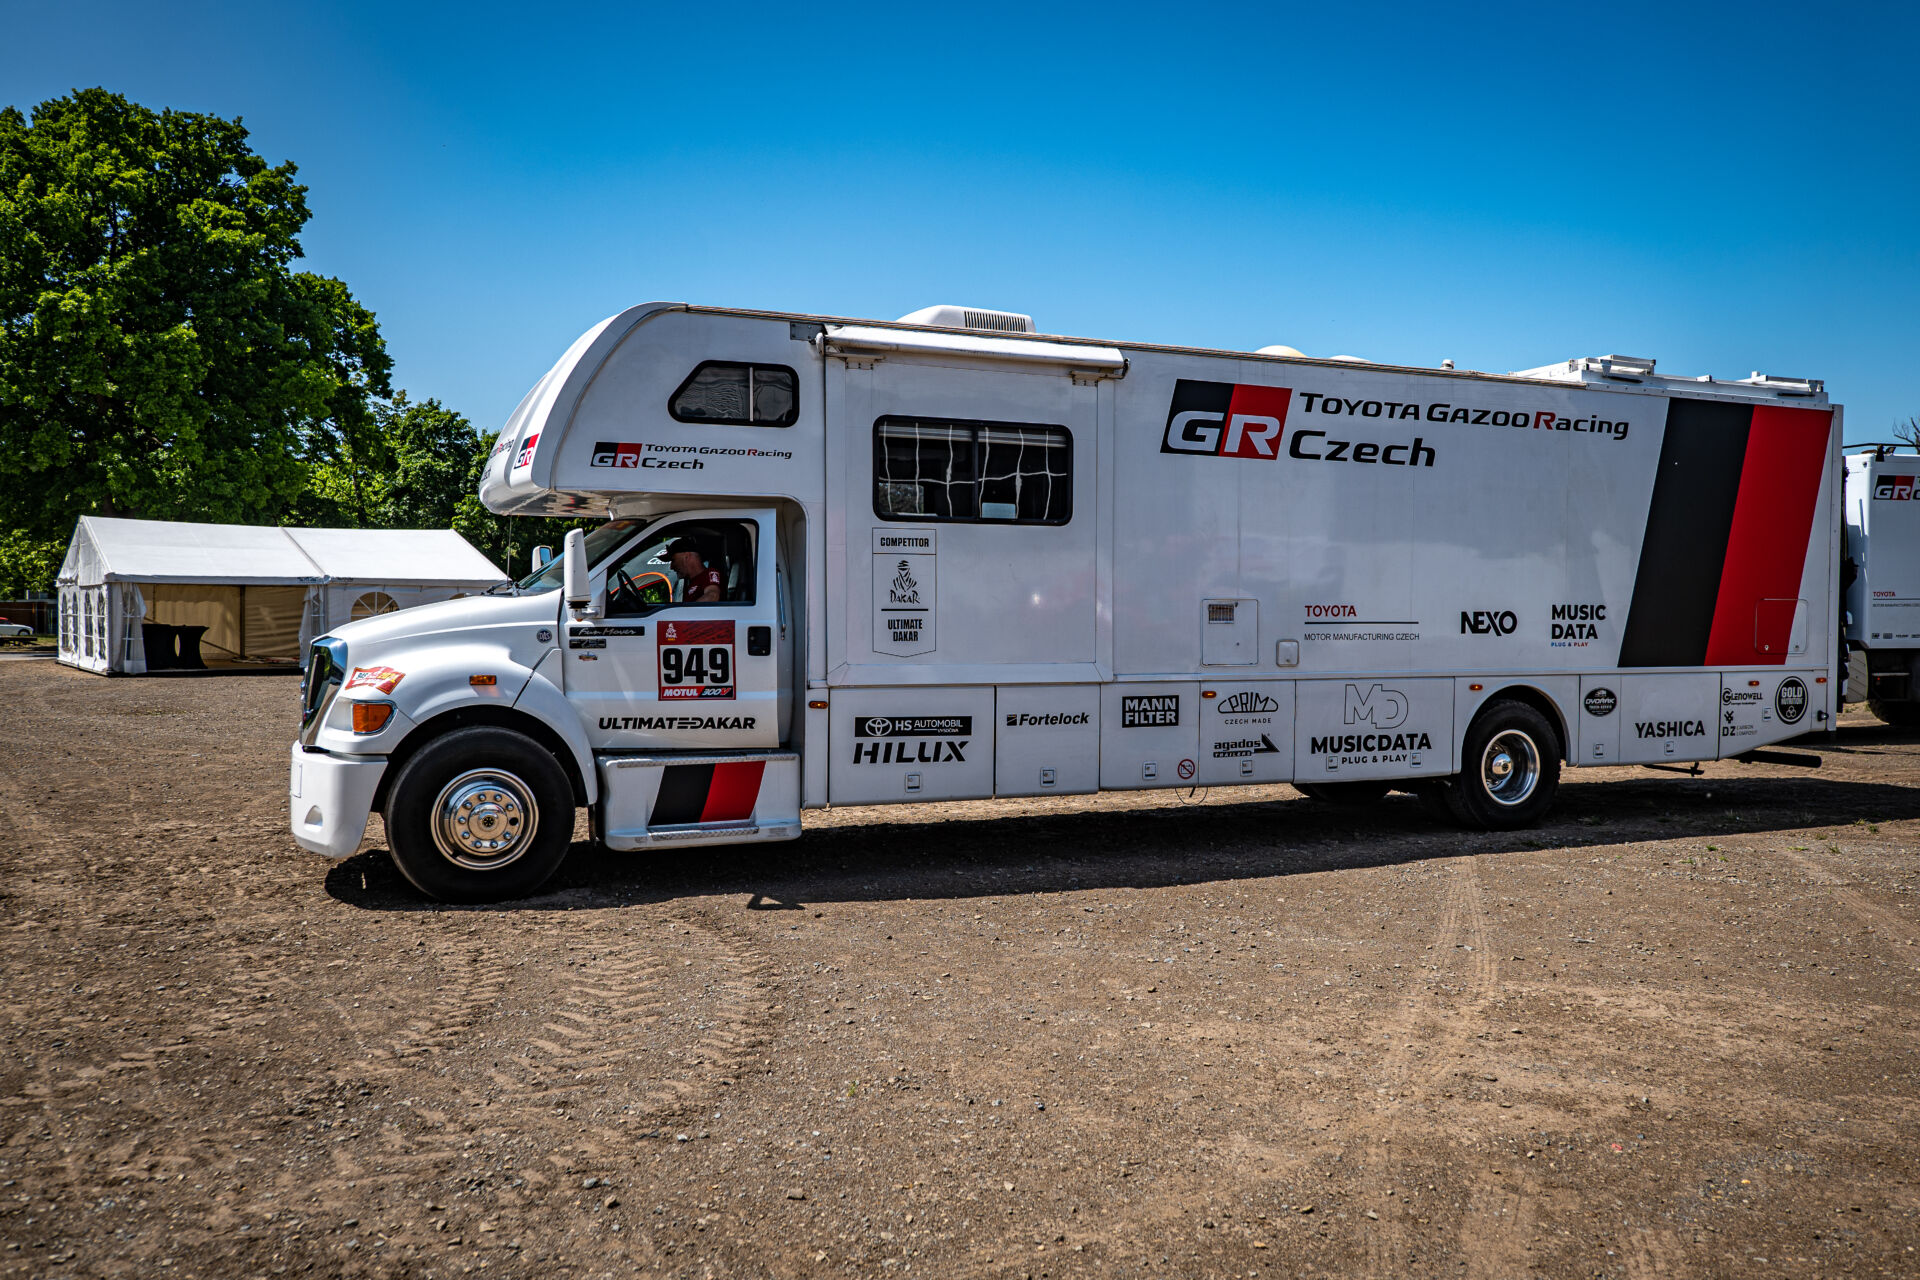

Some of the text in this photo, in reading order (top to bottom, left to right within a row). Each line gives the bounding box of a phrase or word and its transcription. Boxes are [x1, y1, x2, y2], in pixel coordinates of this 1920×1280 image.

[1300, 392, 1629, 441] TOYOTA GAZOO Racing
[1167, 410, 1280, 456] GR
[645, 444, 792, 460] TOYOTA GAZOO Racing
[1289, 430, 1436, 467] Czech
[592, 453, 637, 468] GR
[641, 458, 704, 470] Czech
[1874, 485, 1911, 499] GR
[880, 537, 929, 547] COMPETITOR
[890, 589, 920, 604] DAKAR
[1304, 605, 1357, 617] TOYOTA
[1551, 604, 1606, 620] MUSIC
[888, 619, 923, 630] ULTIMATE
[1460, 610, 1517, 636] NEXO
[893, 631, 918, 641] DAKAR
[1304, 633, 1420, 641] MOTOR MANUFACTURING CZECH
[1551, 624, 1598, 639] DATA
[662, 648, 730, 684] 949
[663, 687, 731, 697] MOTUL 300V
[1782, 687, 1803, 698] GOLD
[1125, 698, 1176, 712] MANN
[895, 719, 963, 731] HS AUTOMOBIL
[1019, 712, 1090, 726] Fortelock
[1125, 712, 1176, 725] FILTER
[1635, 720, 1705, 738] YASHICA
[1214, 739, 1261, 751] agados
[1311, 733, 1432, 754] MUSICDATA
[853, 741, 969, 764] HILUX
[1341, 754, 1408, 764] PLUG & PLAY
